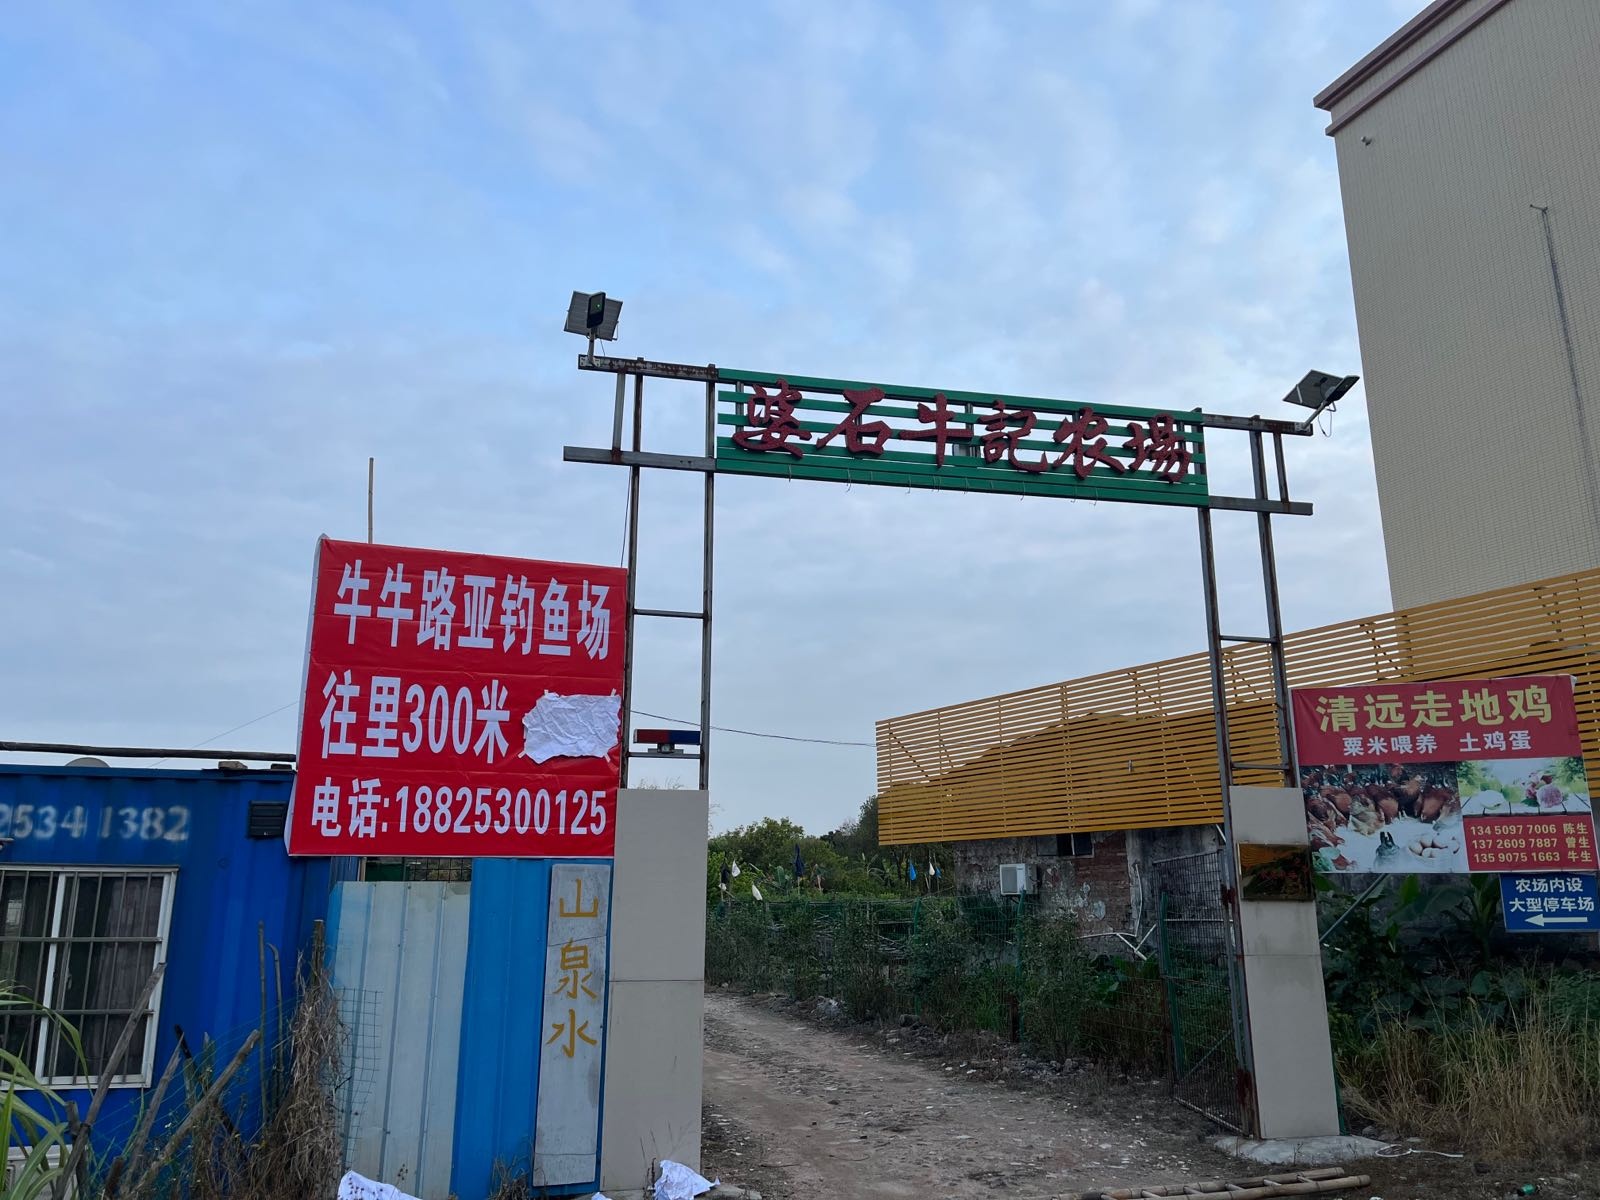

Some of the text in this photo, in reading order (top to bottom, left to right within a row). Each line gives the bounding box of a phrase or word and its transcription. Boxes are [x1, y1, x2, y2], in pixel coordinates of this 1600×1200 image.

[333, 559, 611, 661] 牛牛路亚钓鱼场
[319, 669, 511, 764] 往里300米
[1315, 684, 1552, 733] 清远走地鸡
[1459, 730, 1532, 752] 土鸡蛋
[1470, 822, 1589, 836] 134 5097 7006 陈生
[1472, 836, 1590, 849] 137 2609 7887 曾生
[1474, 850, 1593, 863] 135 9075 1663 牛生
[1515, 877, 1584, 893] 农场内设
[1508, 896, 1595, 913] 大型停车场
[545, 878, 599, 1059] 山泉水
